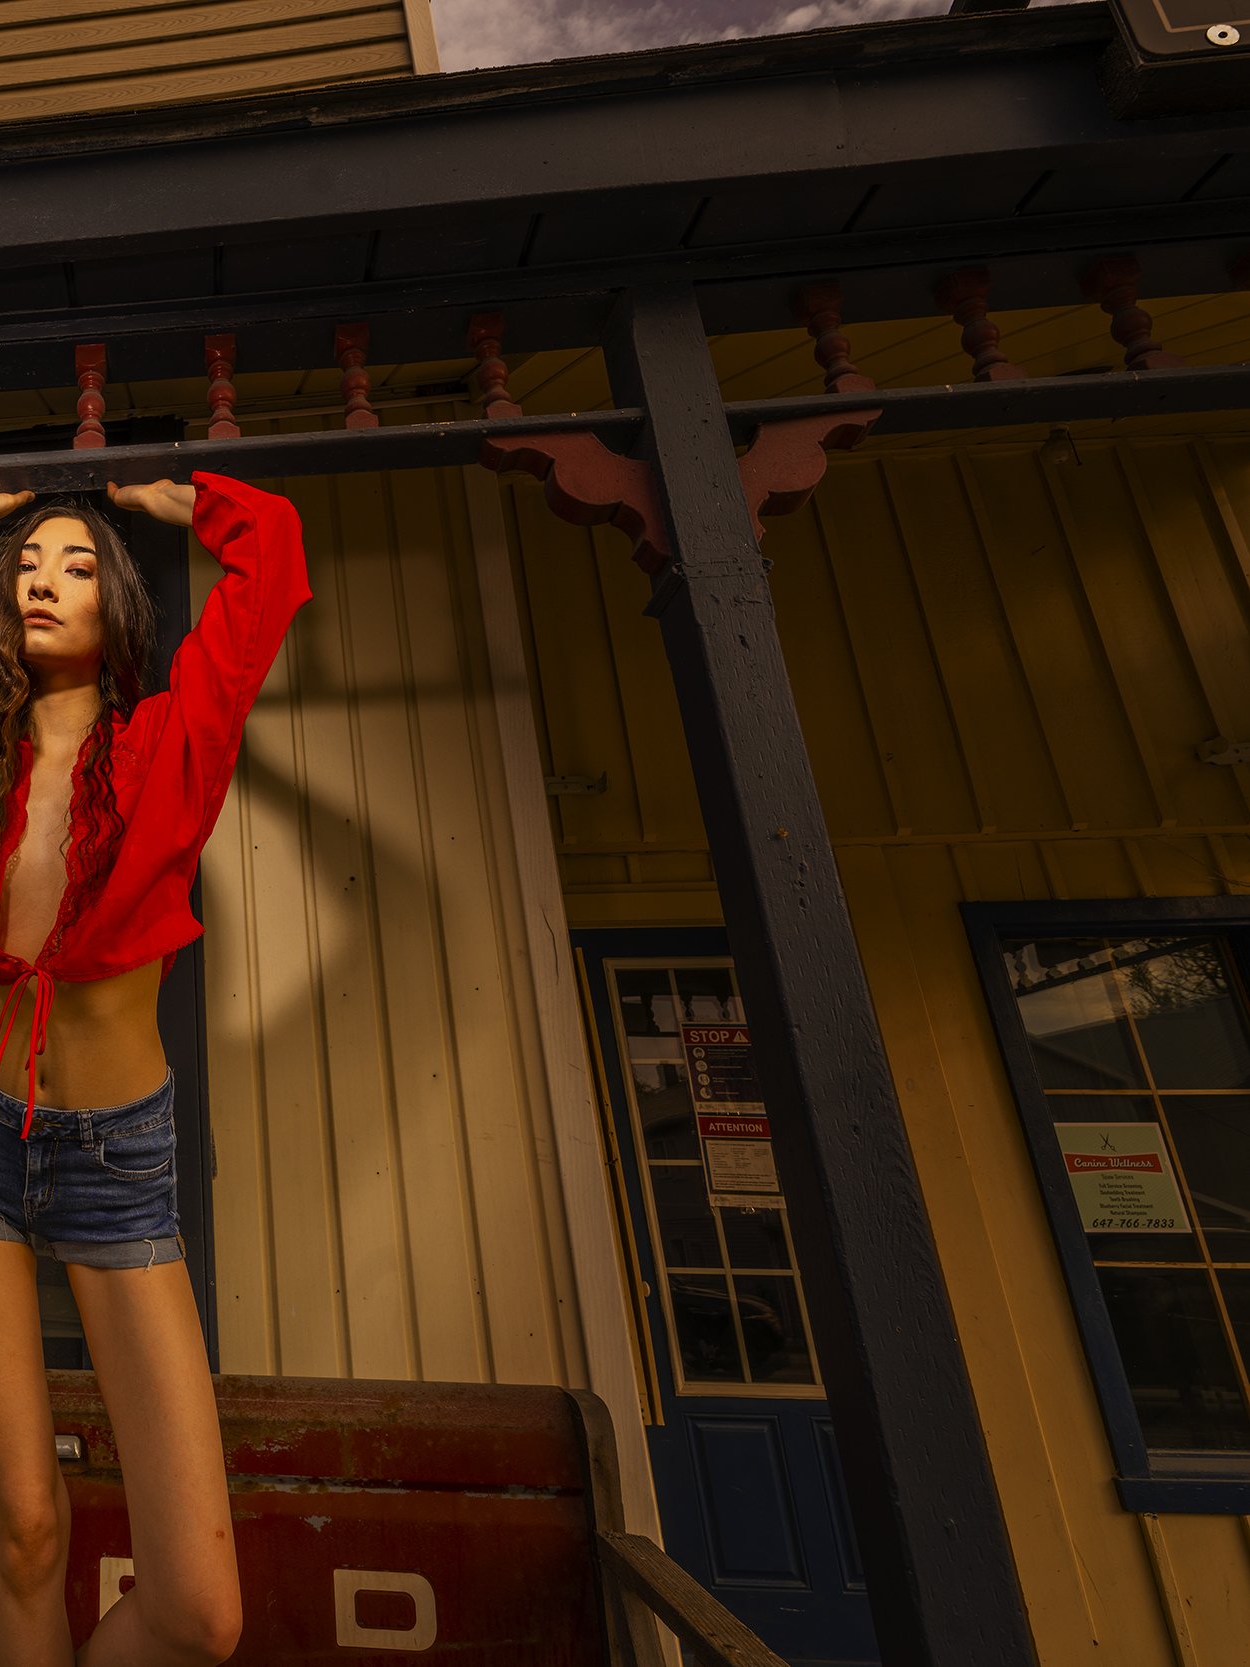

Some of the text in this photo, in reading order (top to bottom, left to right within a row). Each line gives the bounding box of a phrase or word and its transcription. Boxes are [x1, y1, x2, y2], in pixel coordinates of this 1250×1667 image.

[690, 1030, 729, 1043] STOP
[709, 1122, 763, 1133] ATTENTION
[1074, 1158, 1154, 1168] Canine Wellness
[1092, 1218, 1175, 1228] 647-766-7833
